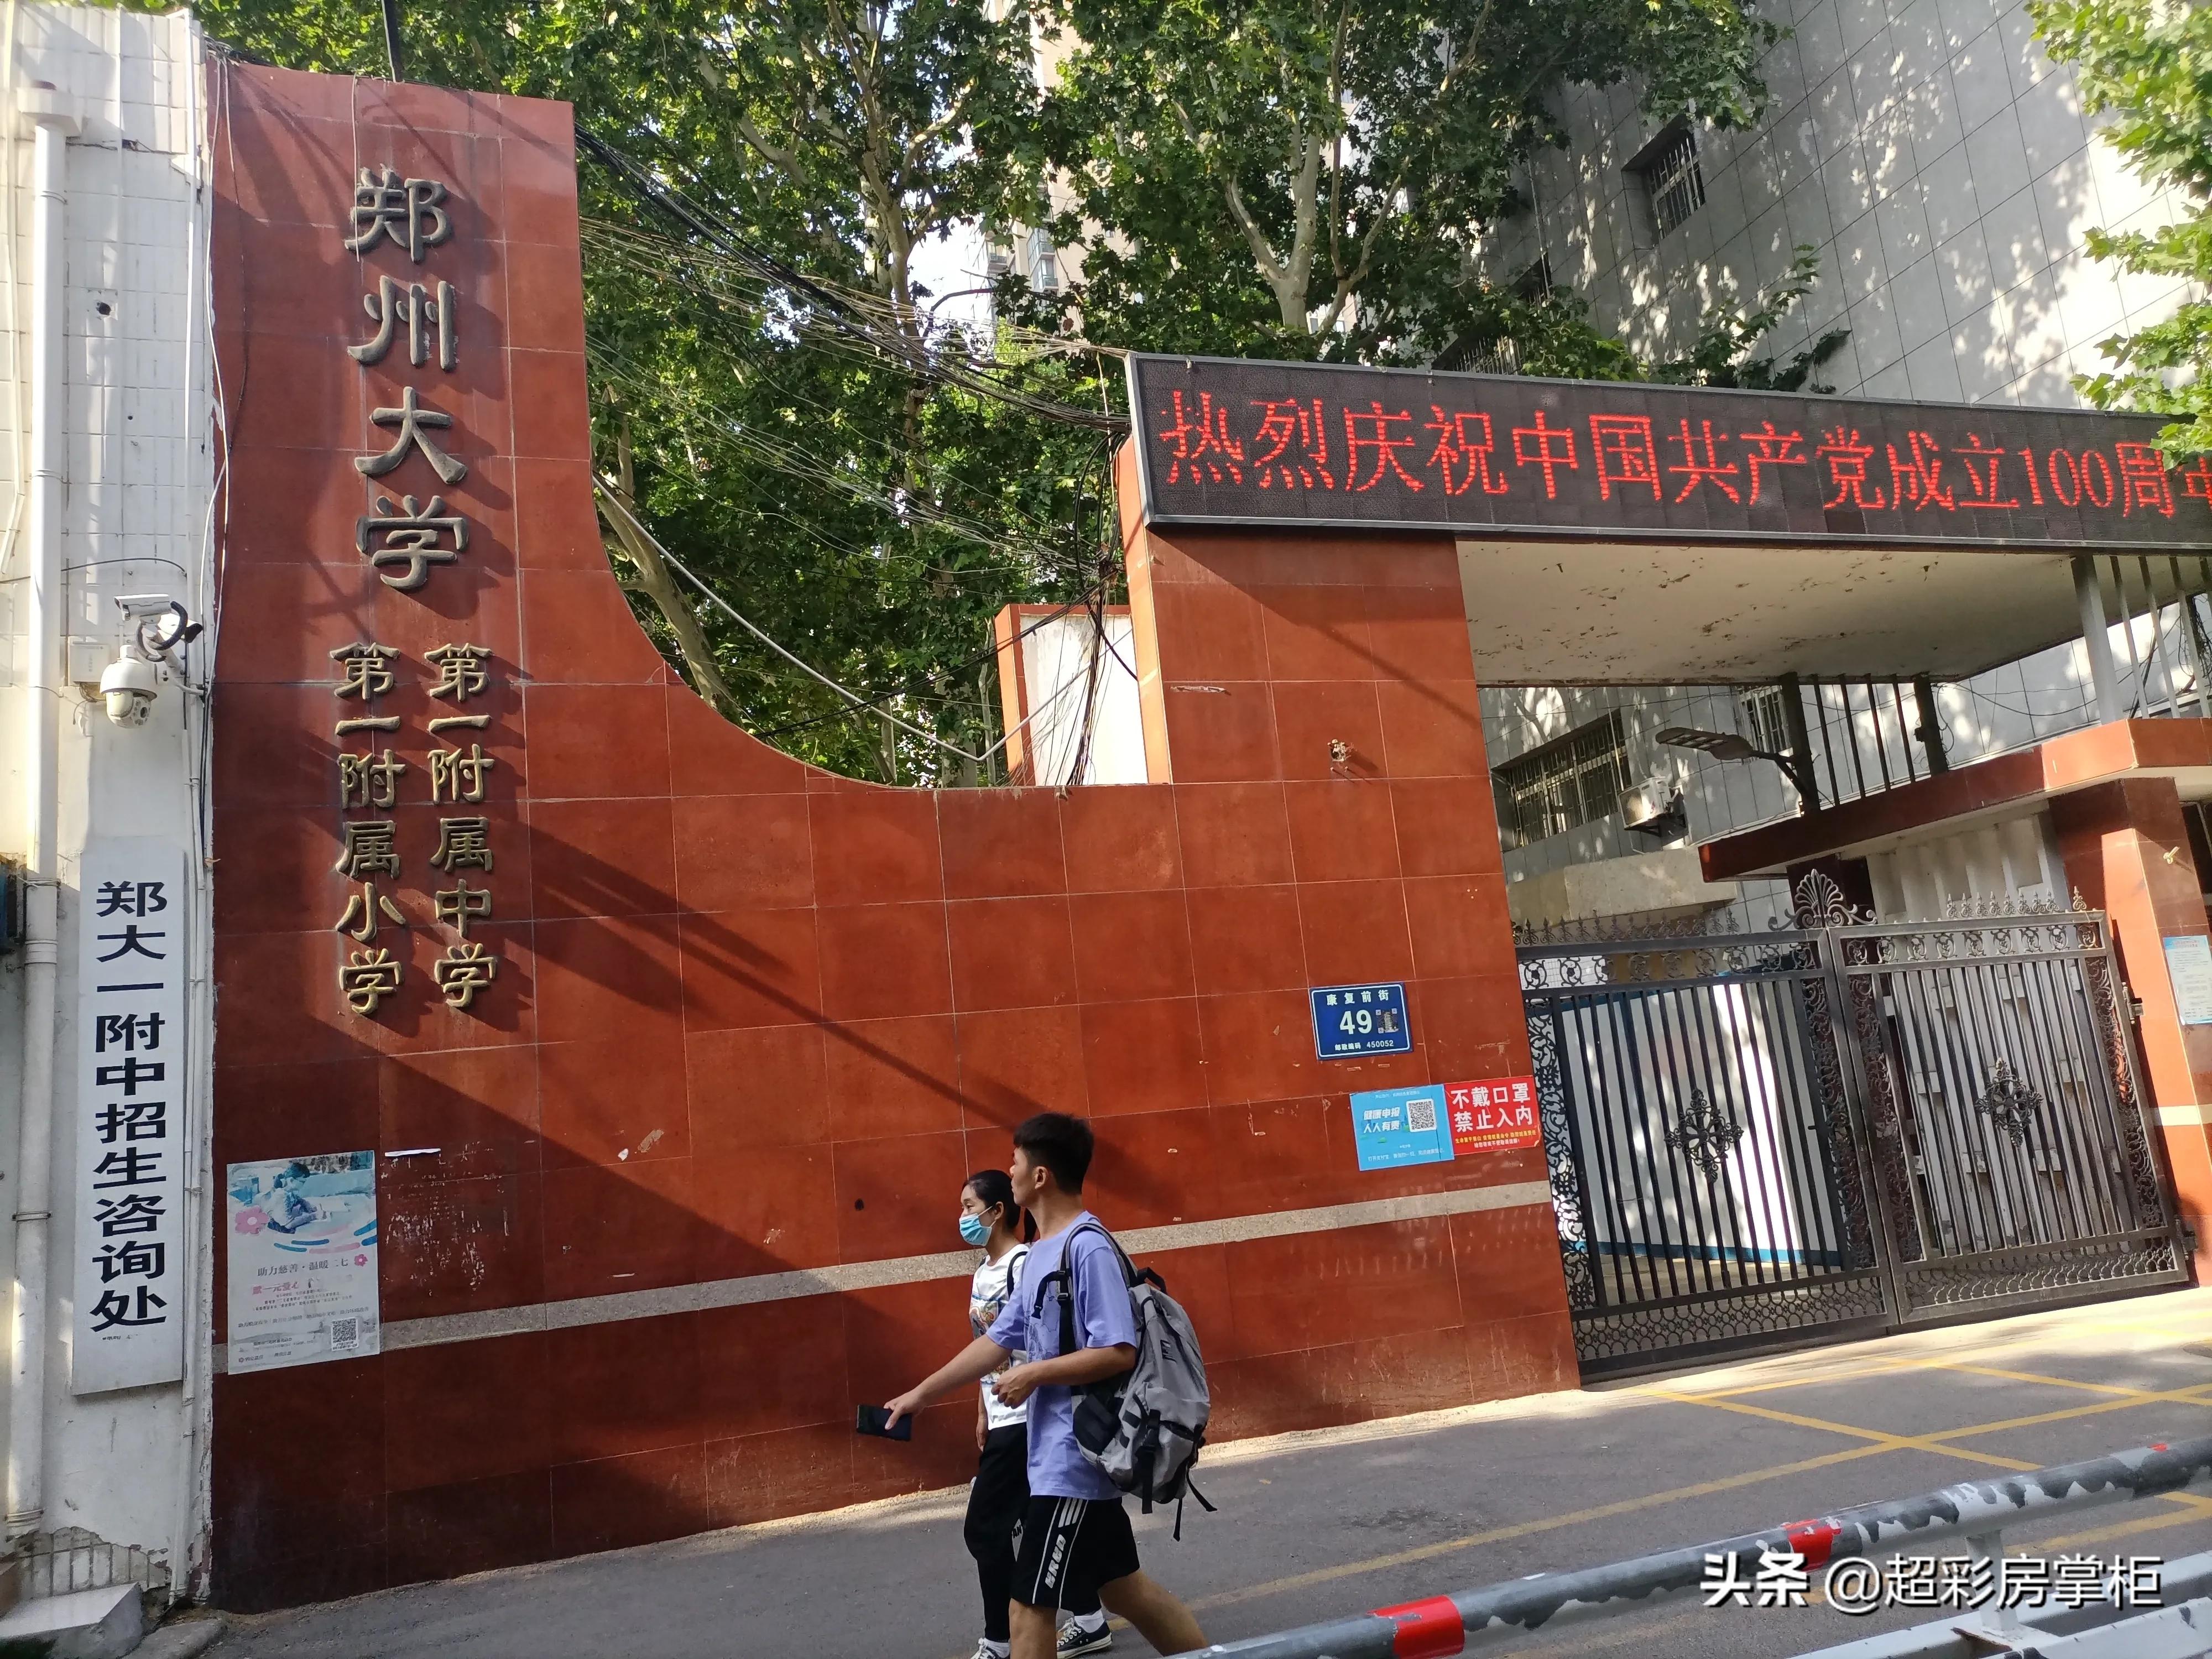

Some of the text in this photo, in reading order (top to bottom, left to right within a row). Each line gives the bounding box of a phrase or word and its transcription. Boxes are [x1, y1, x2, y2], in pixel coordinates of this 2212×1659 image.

[345, 164, 469, 591] 郑州大学
[330, 641, 407, 1015] 第一附属小学
[424, 642, 496, 1008] 第一附属中学
[1327, 989, 1389, 1006] 康复前街
[1339, 1009, 1372, 1035] 49
[1366, 1040, 1394, 1048] 450052
[90, 880, 168, 1333] 郑大一附中招生咨询处
[1451, 1083, 1531, 1109] 不戴口罩
[1363, 1120, 1400, 1134] 人人有责
[1454, 1105, 1533, 1133] 禁止入内
